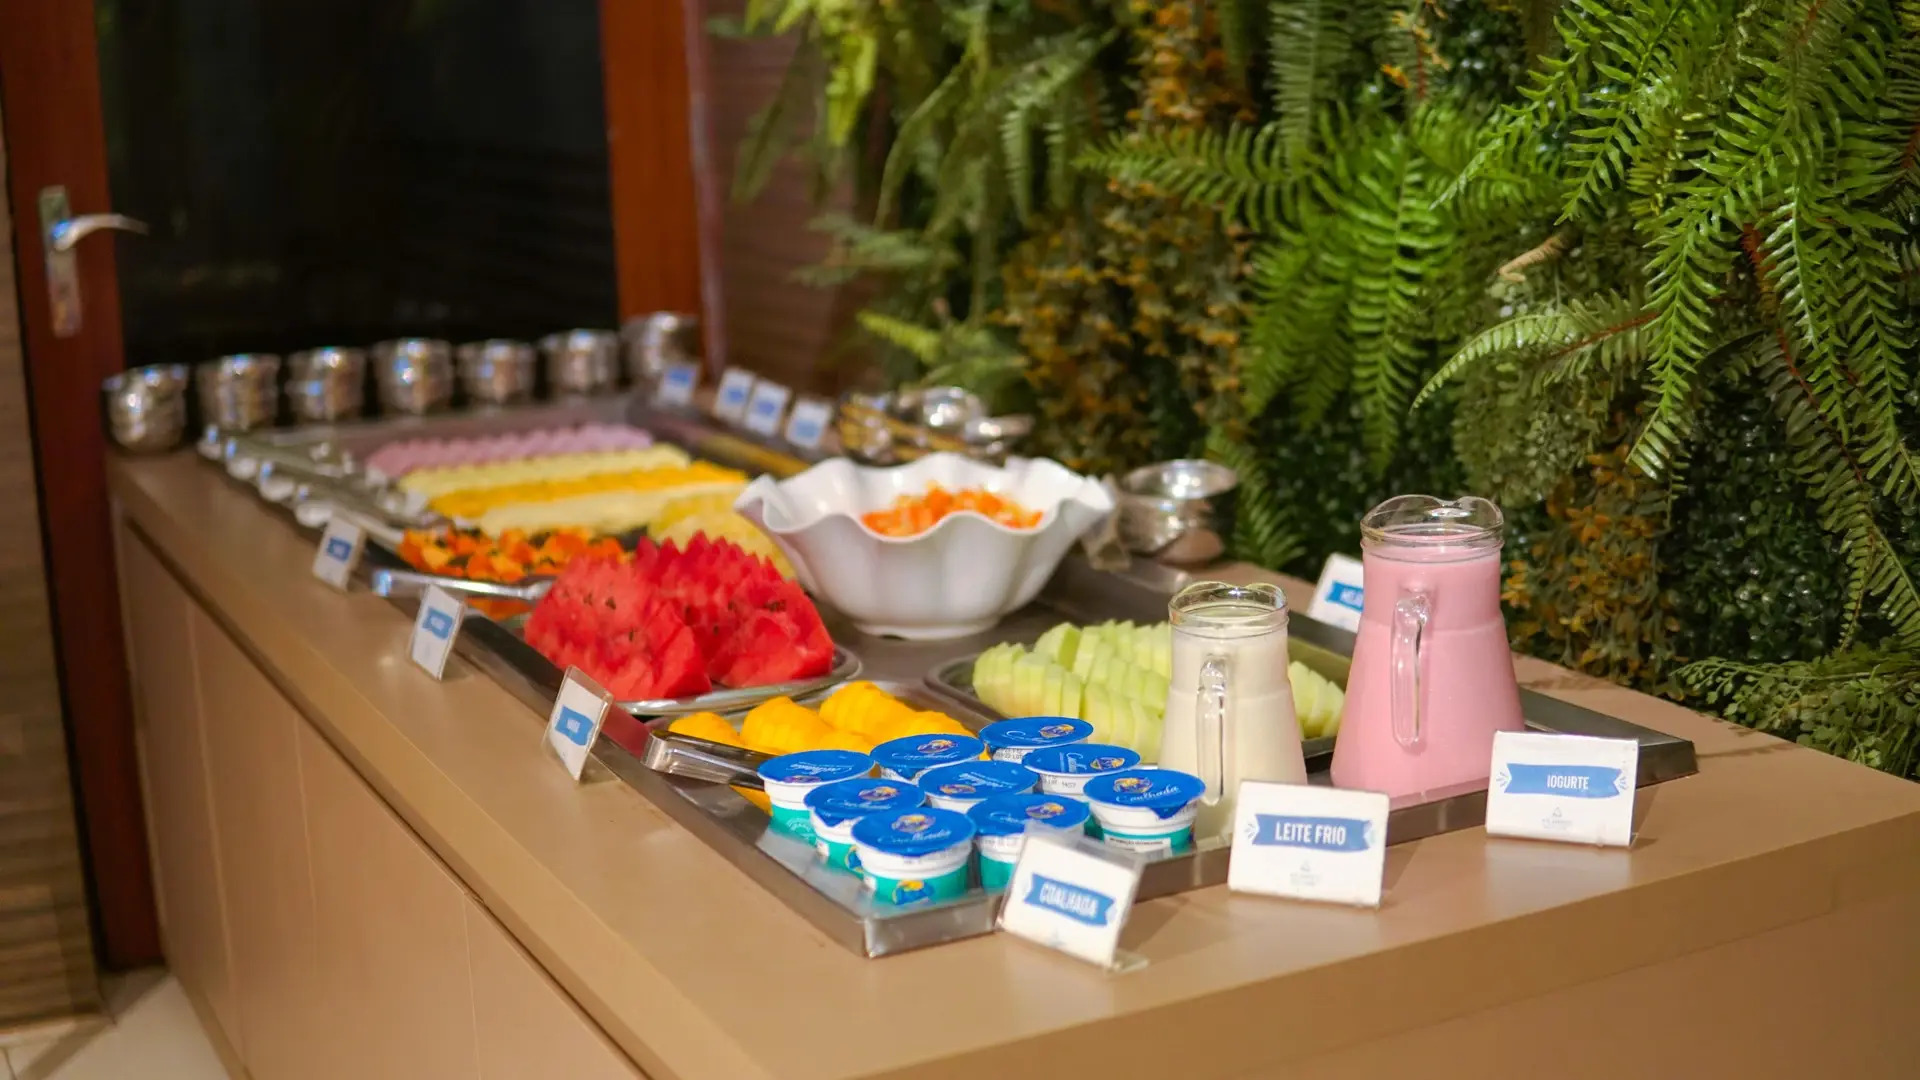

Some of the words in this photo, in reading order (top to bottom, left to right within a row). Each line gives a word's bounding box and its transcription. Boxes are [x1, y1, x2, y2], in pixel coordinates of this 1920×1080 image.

[1546, 774, 1590, 790] IOGURTE
[1274, 820, 1313, 843] LEITE
[1314, 823, 1347, 846] FRIO
